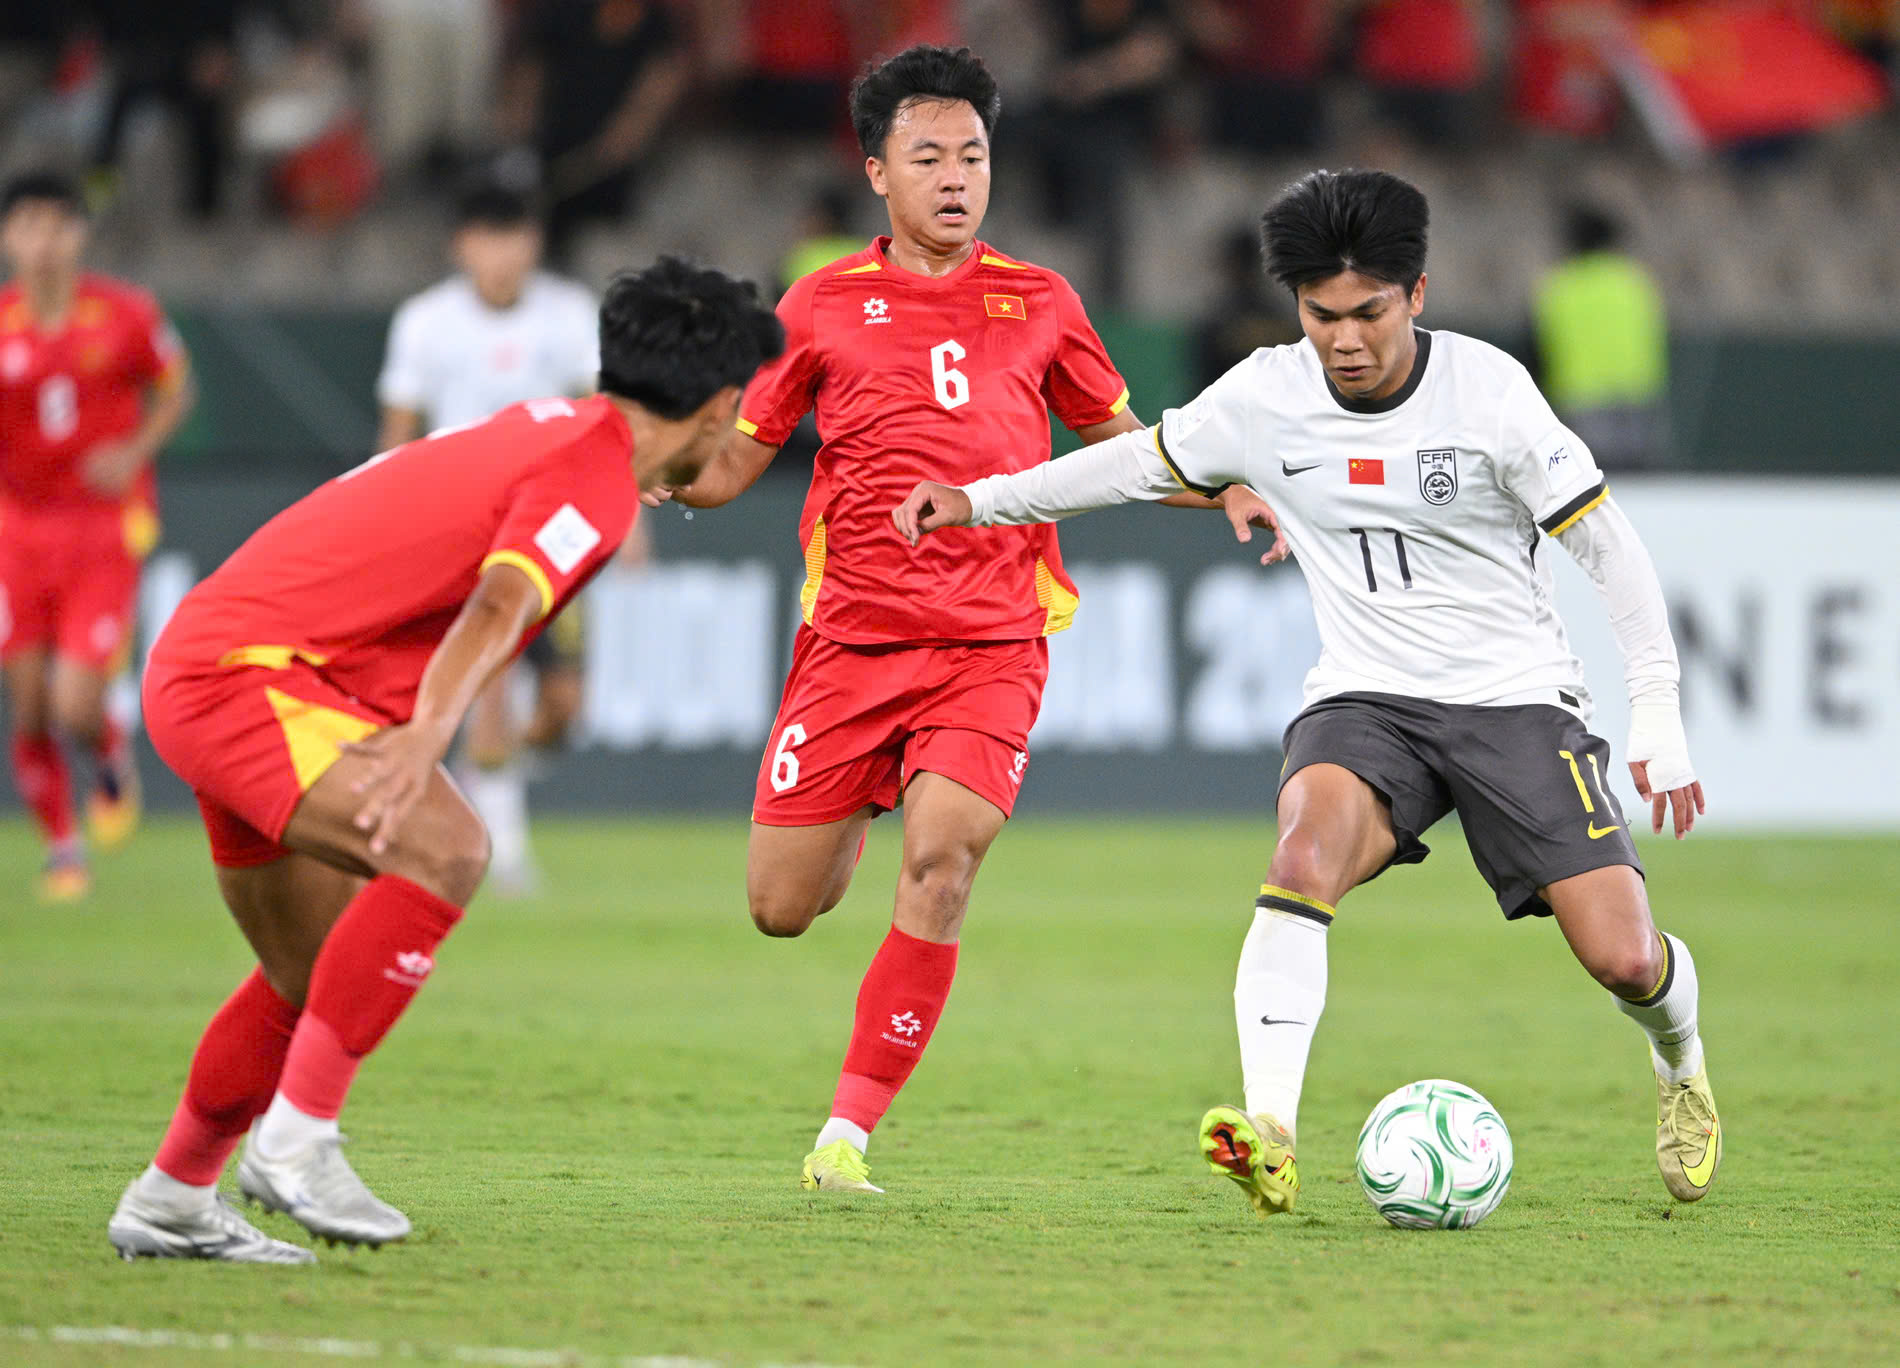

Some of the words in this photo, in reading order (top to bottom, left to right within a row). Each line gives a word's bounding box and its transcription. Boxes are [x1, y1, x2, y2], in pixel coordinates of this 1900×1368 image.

[930, 339, 970, 410] 6
[1421, 452, 1453, 464] CFA
[1548, 446, 1568, 471] AFC
[1348, 527, 1413, 593] 11
[770, 723, 807, 793] 6
[1558, 750, 1616, 819] 11
